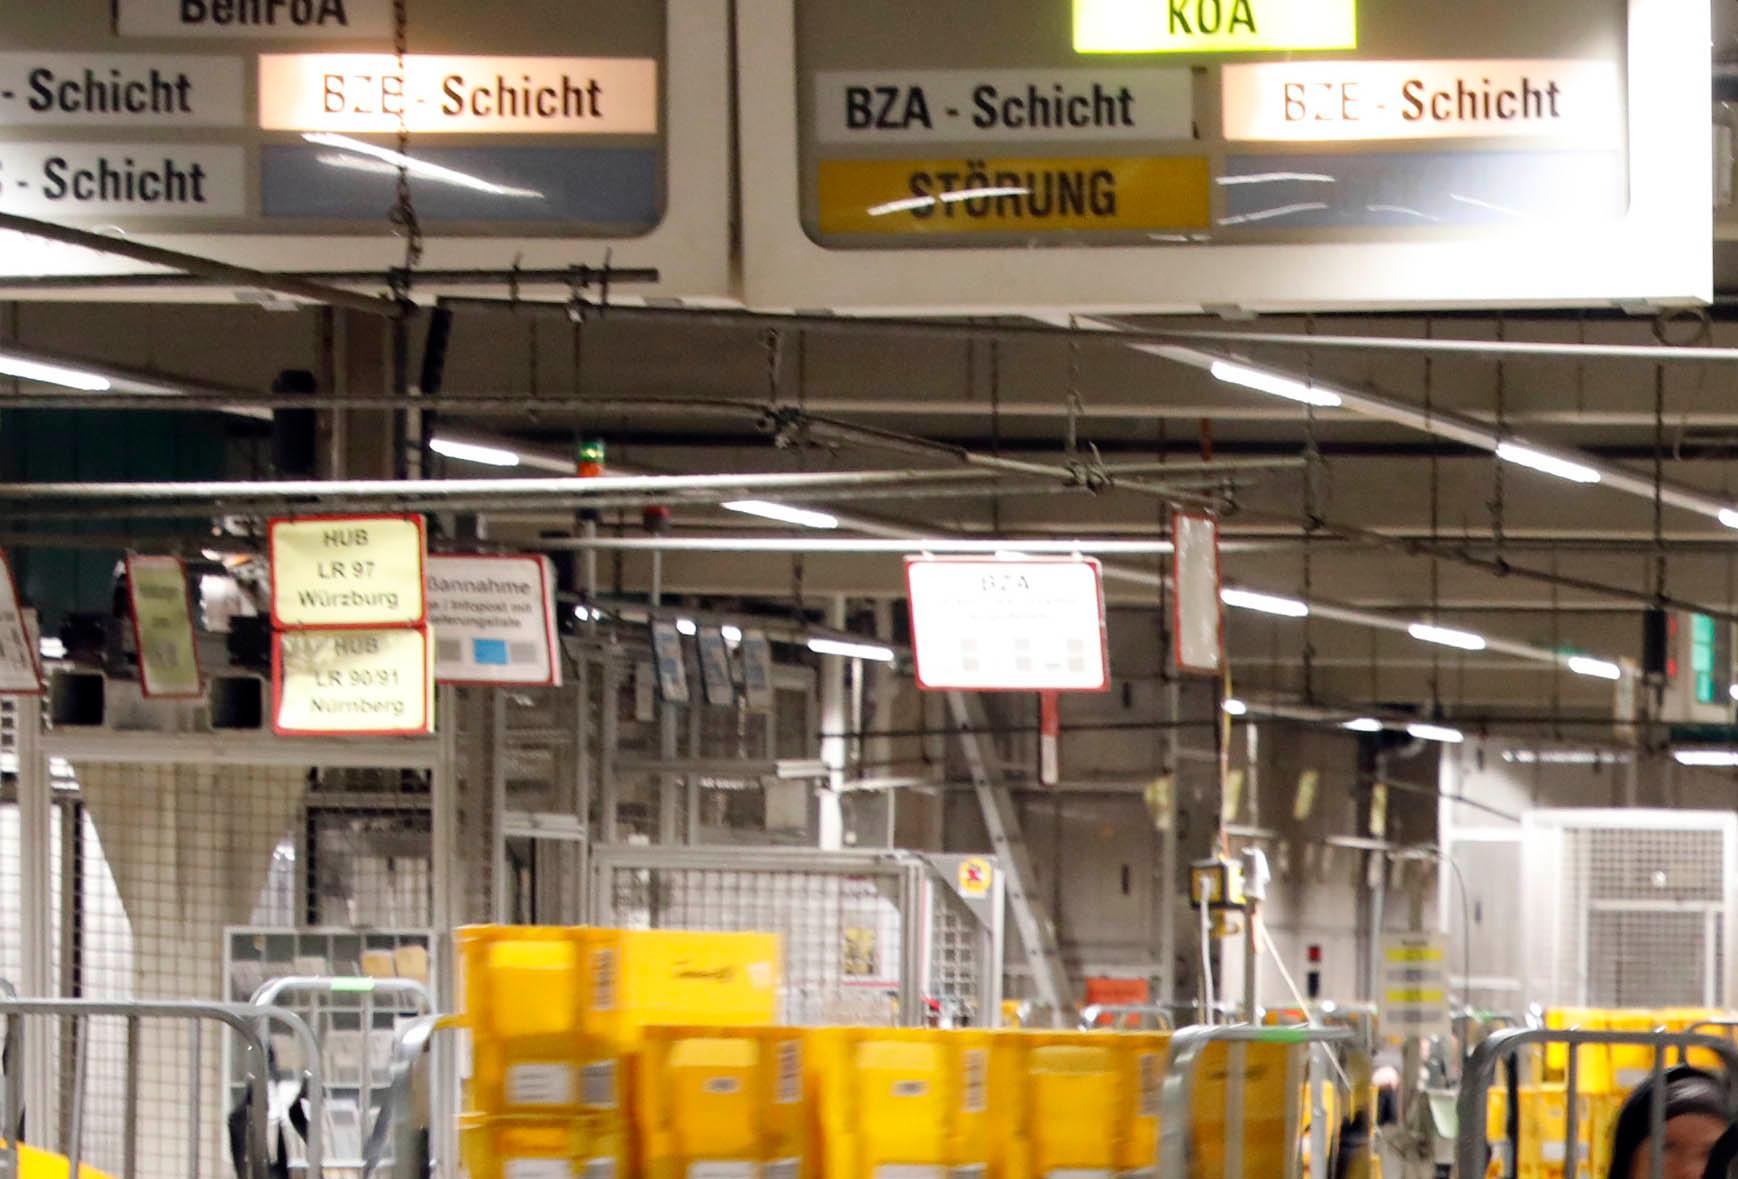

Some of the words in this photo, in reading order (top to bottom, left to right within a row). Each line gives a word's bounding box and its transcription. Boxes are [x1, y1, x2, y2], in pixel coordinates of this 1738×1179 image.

[28, 67, 193, 113] Schicht
[441, 73, 603, 118] Schicht
[844, 85, 933, 131] BZA
[971, 84, 1136, 130] Schicht
[1400, 76, 1562, 122] Schicht
[42, 156, 208, 203] Schicht
[907, 160, 1118, 220] STÖRUNG
[322, 528, 369, 547] HUB
[317, 561, 345, 580] LR
[351, 561, 376, 578] 97
[297, 589, 400, 610] Würzburg
[333, 636, 380, 656] HUB
